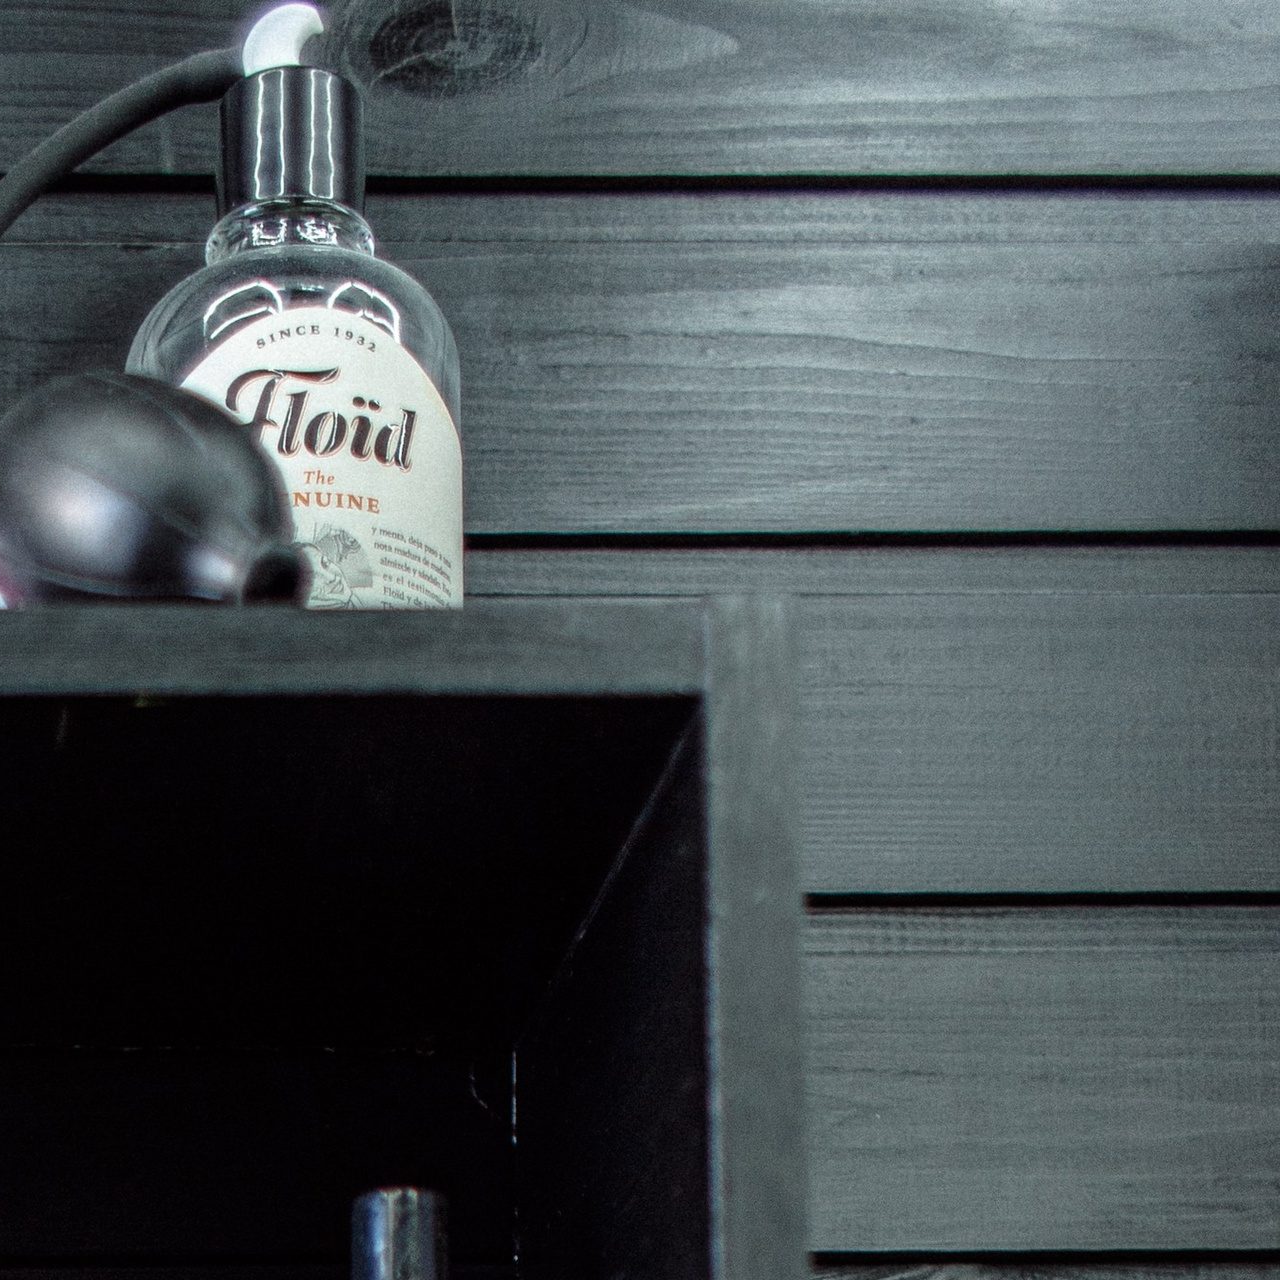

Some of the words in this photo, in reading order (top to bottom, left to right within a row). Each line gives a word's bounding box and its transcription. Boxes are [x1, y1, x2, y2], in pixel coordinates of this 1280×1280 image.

[256, 325, 320, 349] SINCE
[334, 328, 377, 352] 1932
[225, 366, 417, 472] Floïd
[303, 470, 335, 485] The
[293, 491, 381, 514] NUINE
